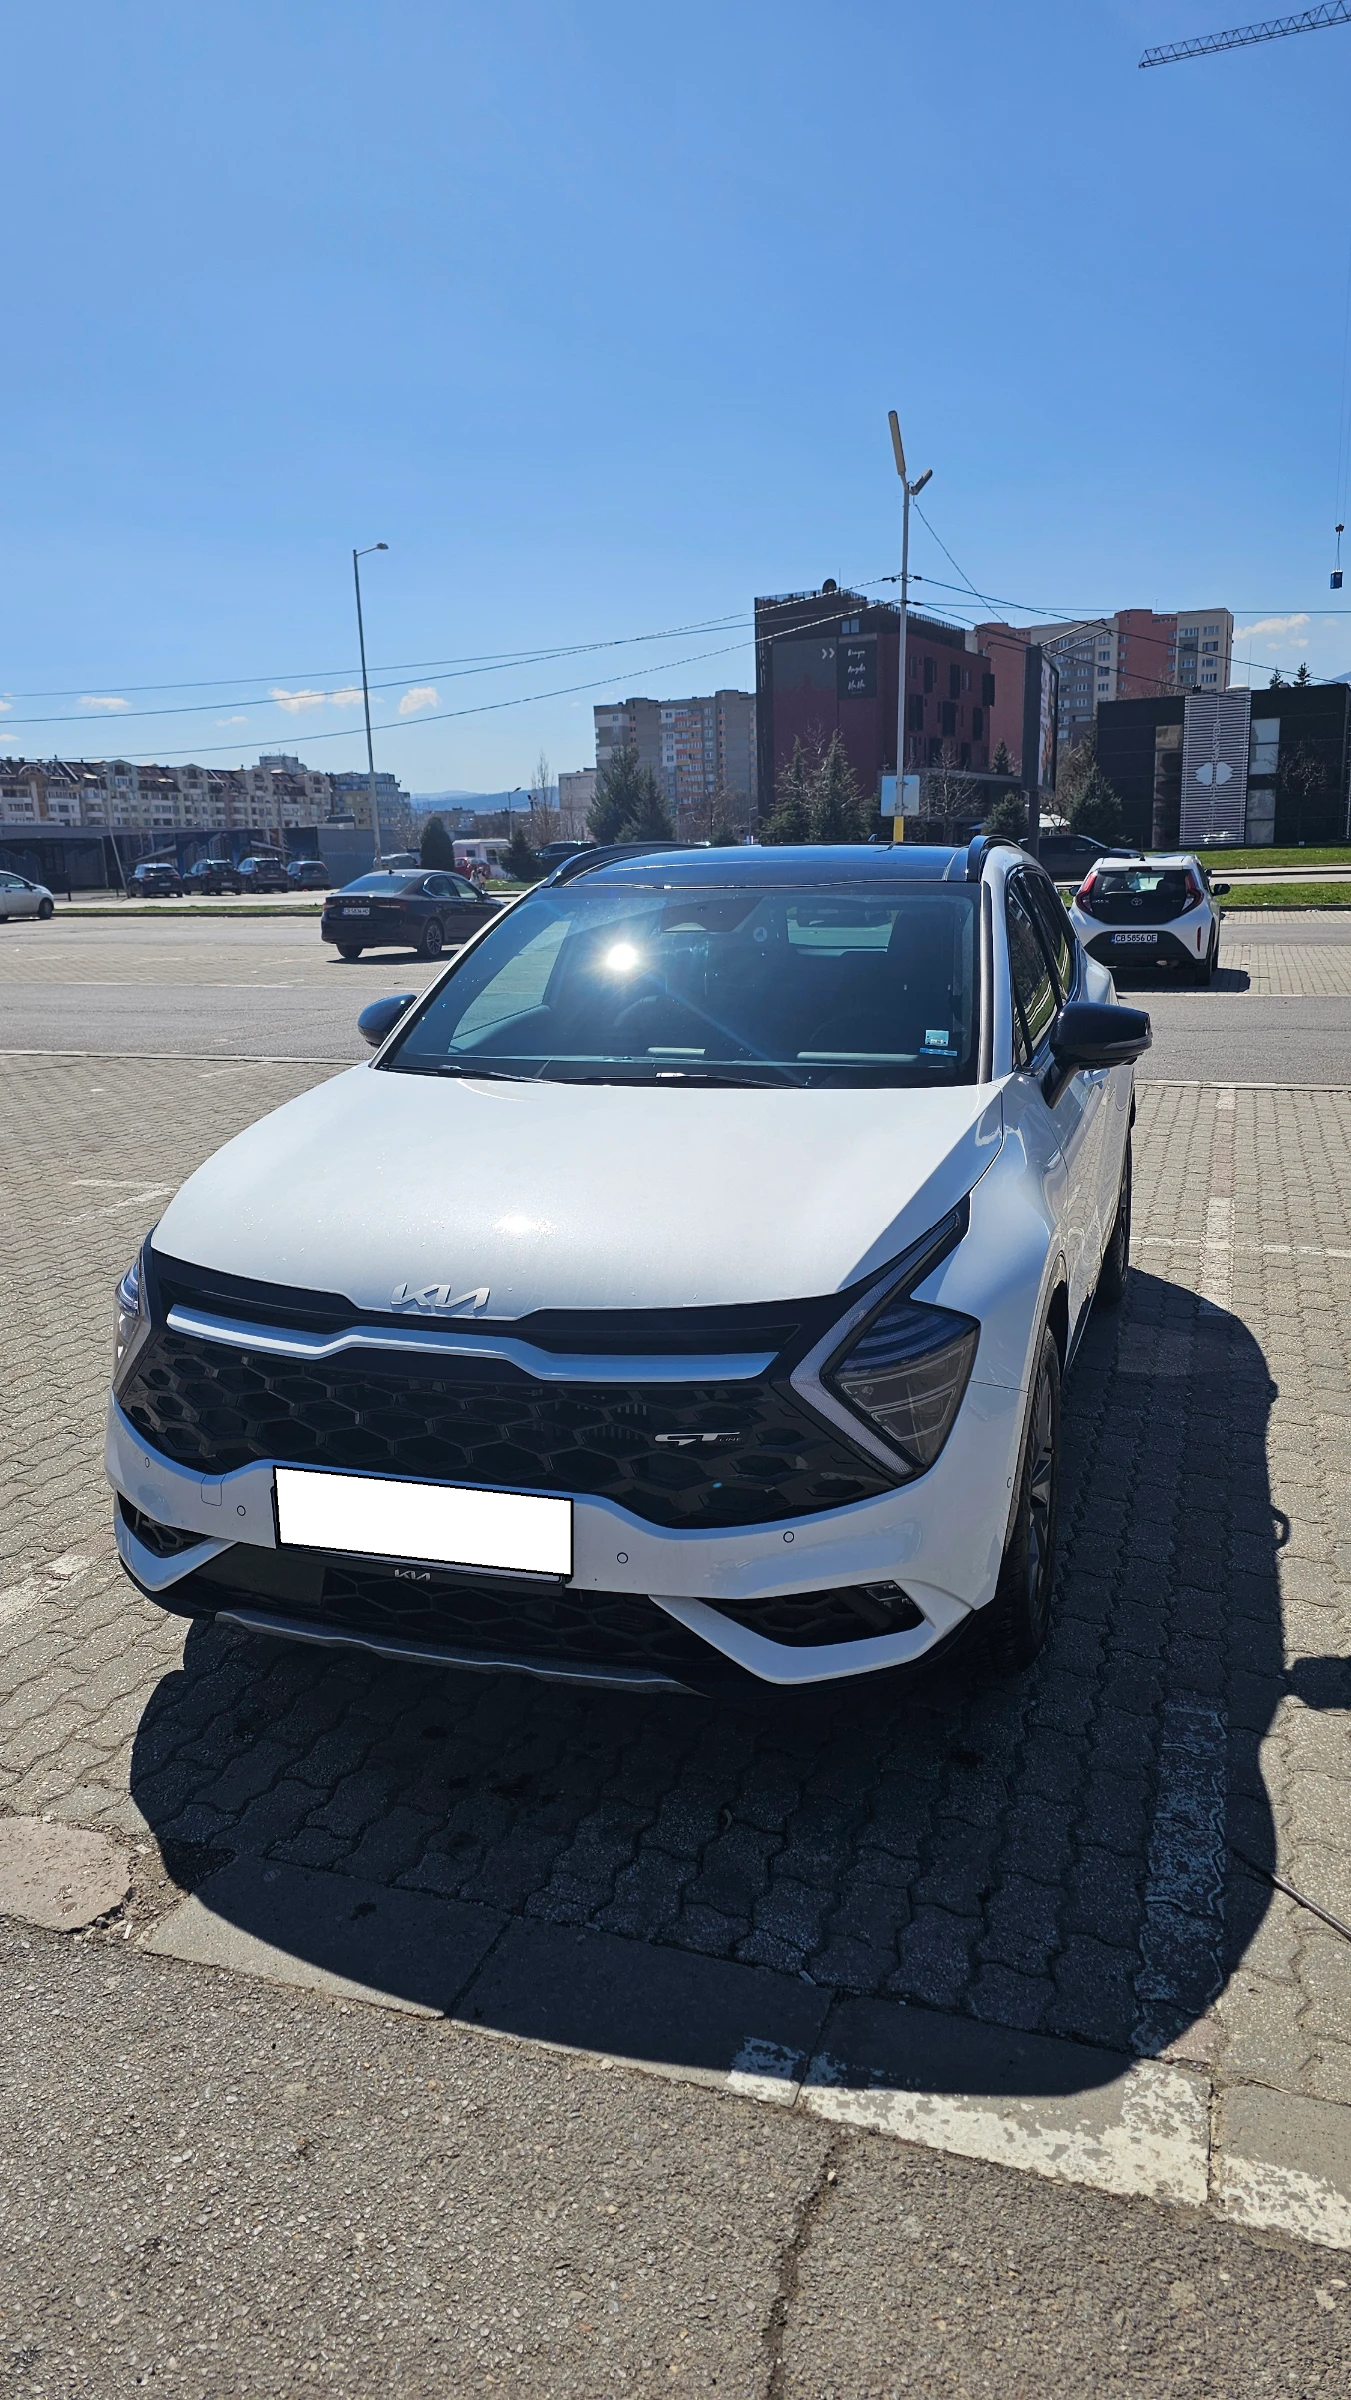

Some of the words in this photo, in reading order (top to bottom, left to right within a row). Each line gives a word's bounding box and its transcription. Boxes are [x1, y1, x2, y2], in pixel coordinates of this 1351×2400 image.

[1115, 934, 1126, 942] CB
[1146, 934, 1157, 942] OE
[390, 1282, 490, 1315] KIA
[655, 1431, 740, 1446] GT
[394, 1569, 431, 1581] KIA
